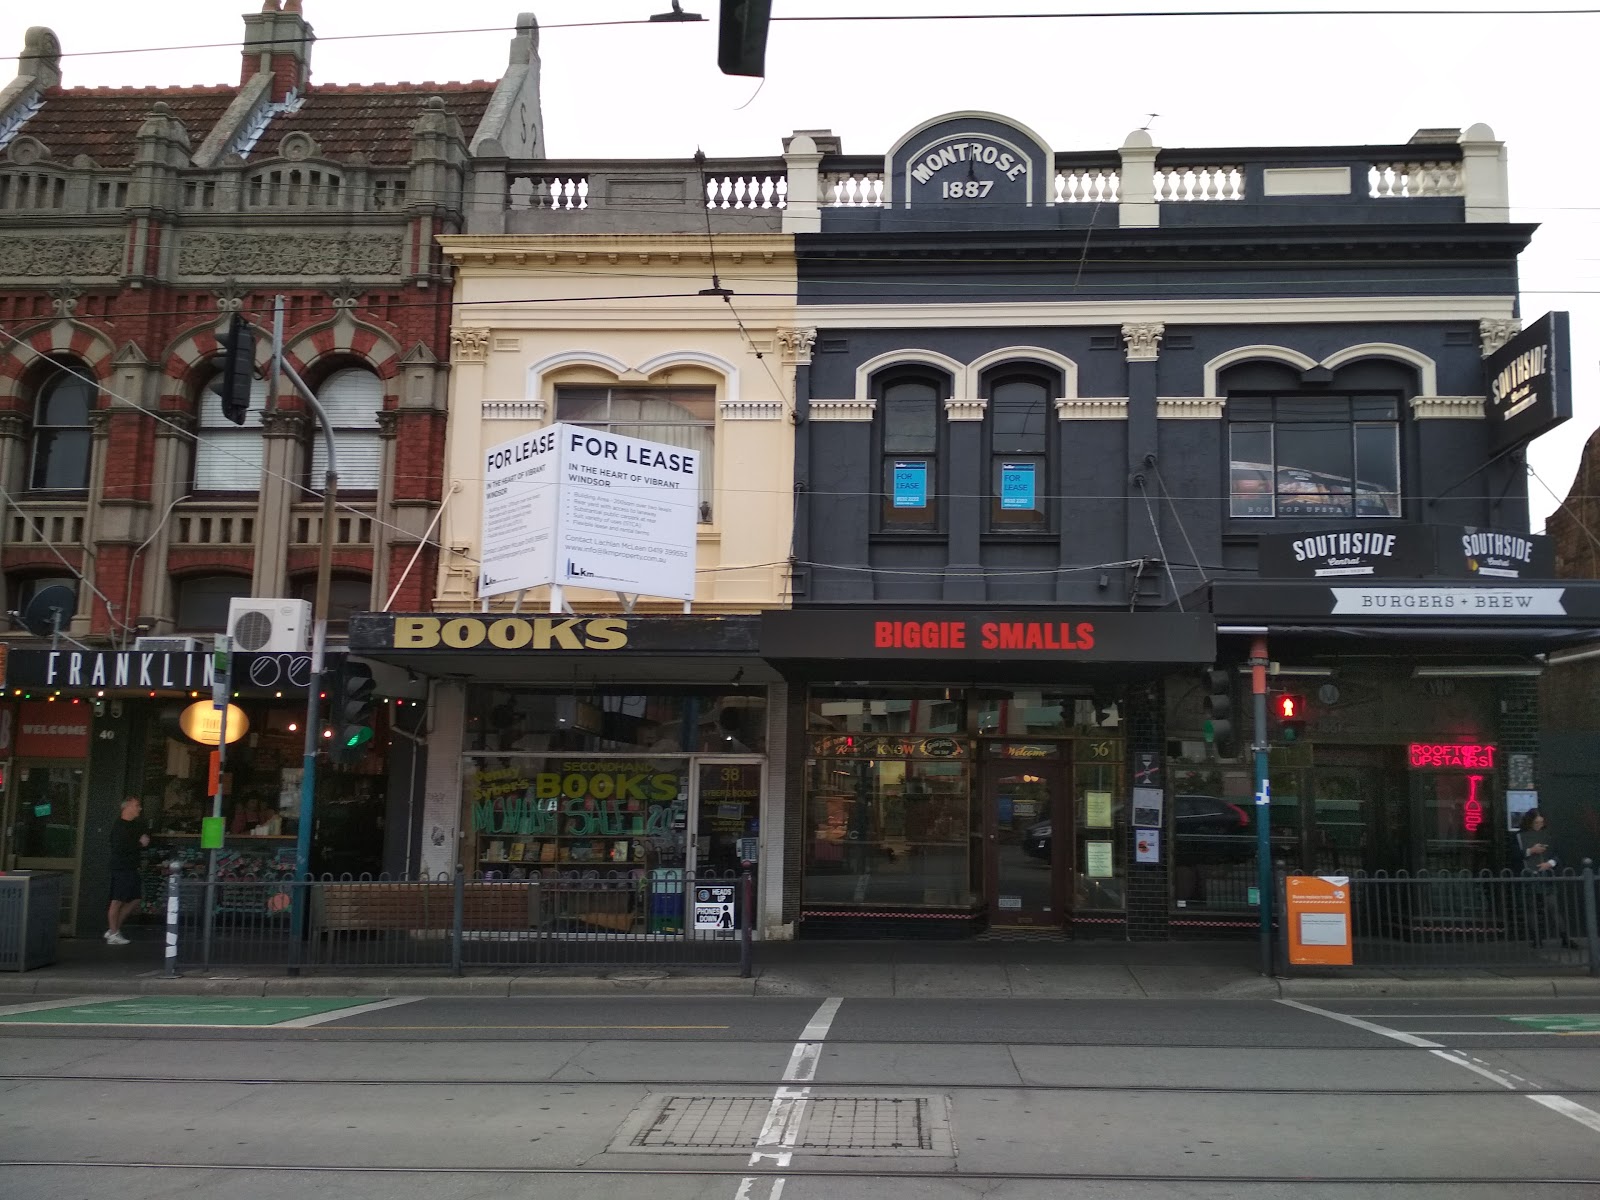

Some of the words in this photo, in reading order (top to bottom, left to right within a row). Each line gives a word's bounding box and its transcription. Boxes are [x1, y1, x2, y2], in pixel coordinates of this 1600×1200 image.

[911, 142, 1027, 185] MONTROSE
[942, 180, 994, 199] 1887
[1491, 344, 1548, 405] SOUTHSIDE
[487, 448, 512, 473] FOR
[515, 432, 555, 463] LEASE
[571, 433, 618, 460] FOR
[626, 445, 694, 474] LEASE
[568, 462, 579, 471] IN
[580, 465, 598, 475] THE
[599, 468, 628, 480] HEART
[630, 474, 642, 482] OF
[644, 476, 680, 489] VIBRANT
[568, 473, 611, 488] WINDSOR
[1004, 474, 1021, 482] FOR
[896, 482, 920, 490] LEASE
[565, 534, 593, 544] Contact
[621, 542, 647, 551] McLean
[1292, 532, 1397, 561] SOUTHSIDE
[1462, 533, 1533, 563] SOUTHSIDE
[1327, 557, 1361, 566] Central
[1361, 595, 1455, 608] BURGERS
[1474, 595, 1534, 608] BREW
[394, 617, 628, 651] BOOKS
[874, 621, 966, 649] BIGGIE
[981, 622, 1096, 651] SMALLS
[47, 651, 215, 688] FRANKLIN
[22, 724, 88, 735] WELCOME
[99, 730, 114, 740] 40
[1007, 746, 1048, 757] Welcome
[1090, 742, 1108, 758] 36
[1410, 744, 1482, 756] ROOFTOP
[563, 761, 655, 772] SECONDHAND
[1411, 755, 1489, 768] UPSTAIRS
[720, 767, 740, 781] 38
[535, 772, 678, 800] BOOKS
[562, 797, 627, 836] SALE
[711, 888, 732, 896] HEADS
